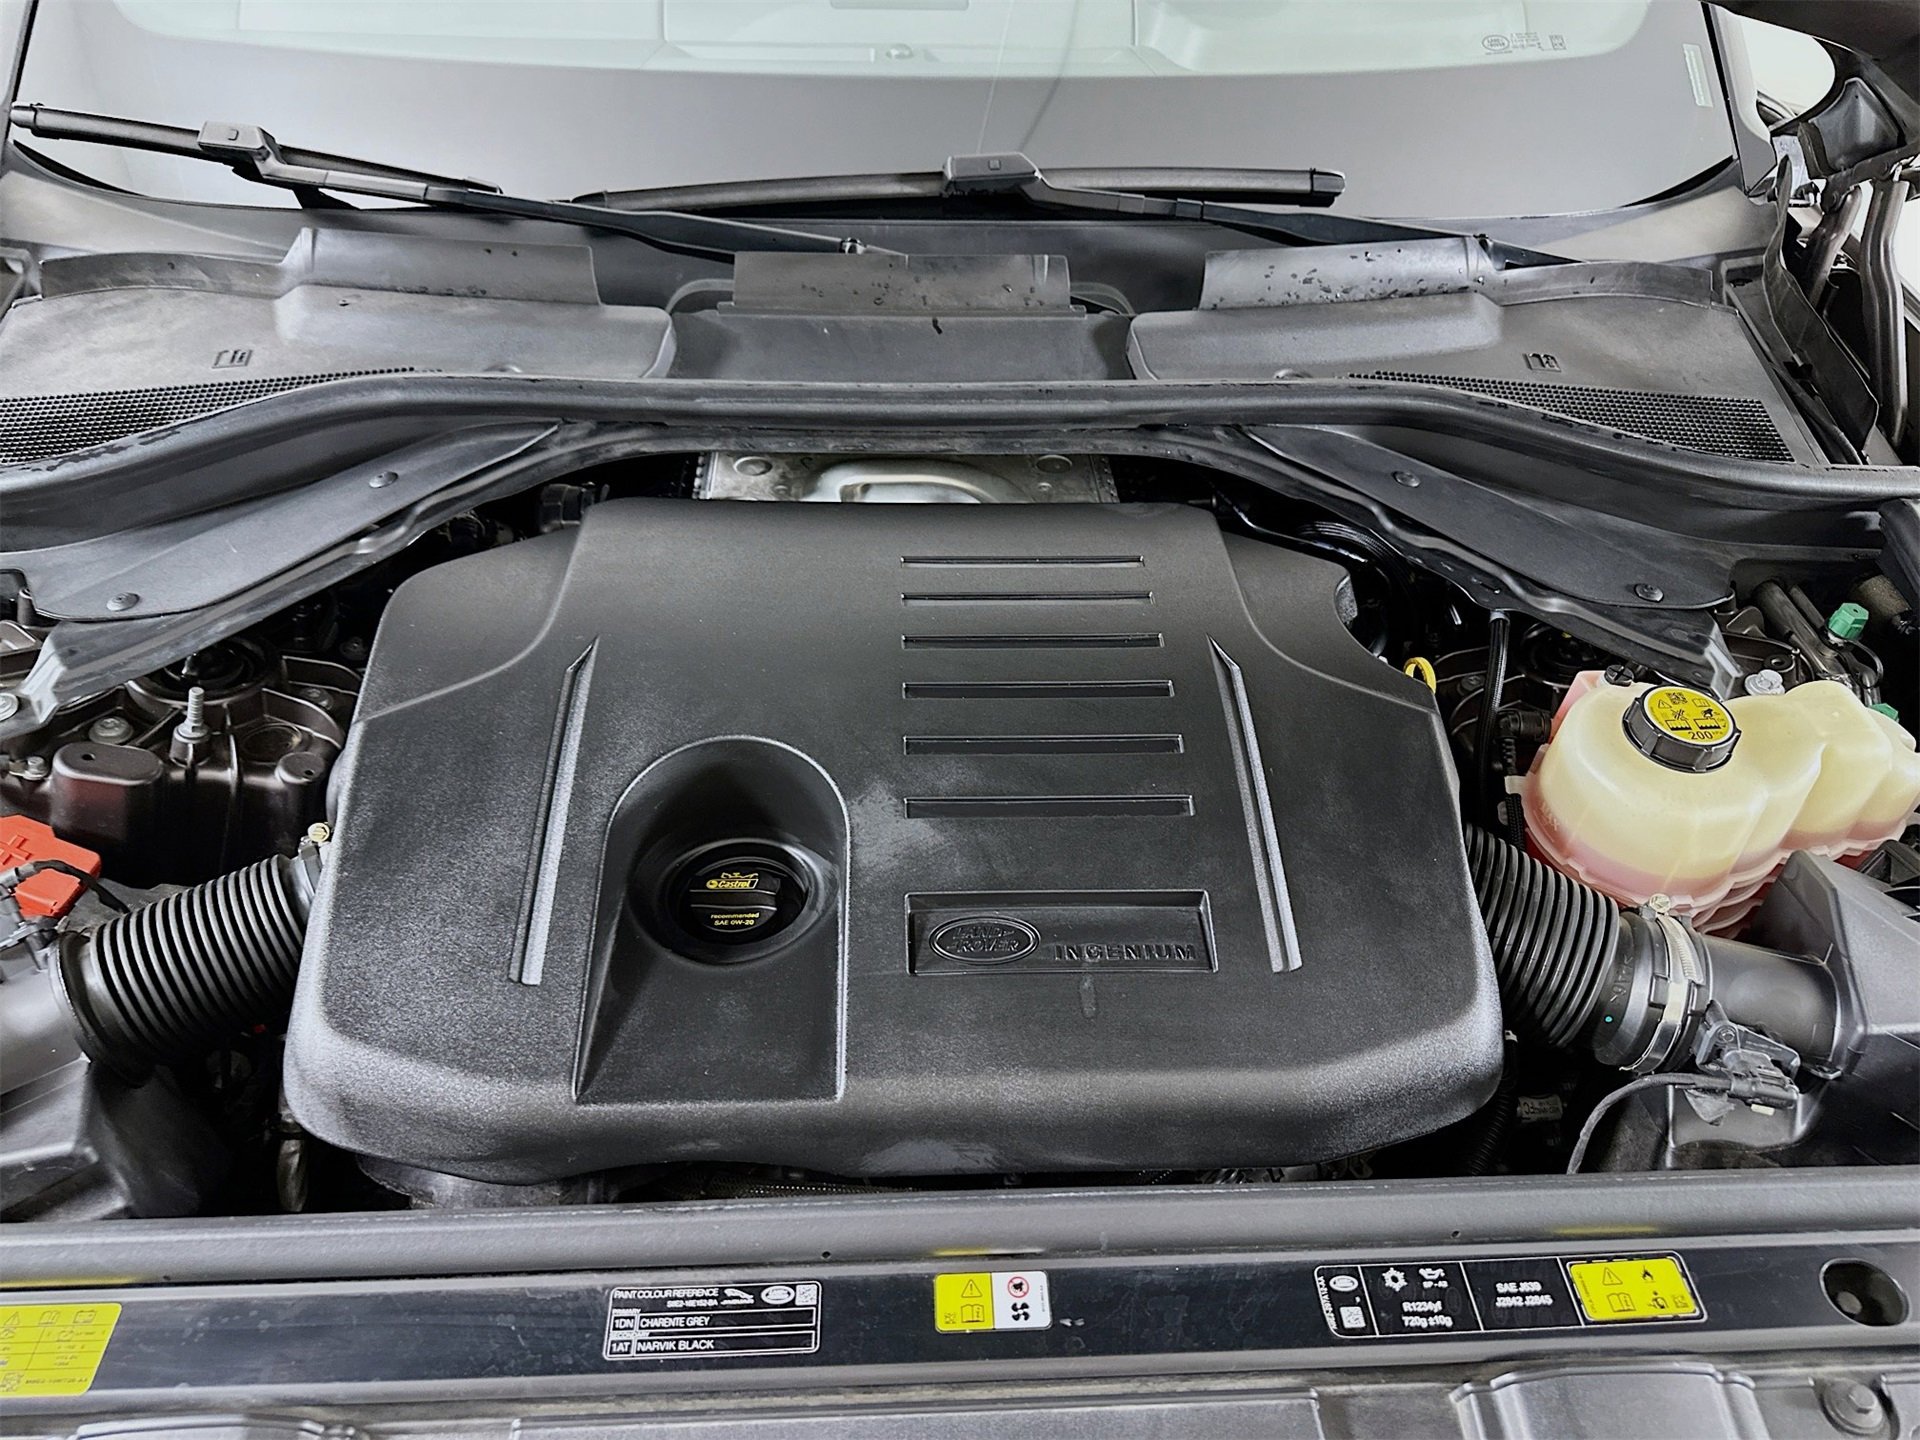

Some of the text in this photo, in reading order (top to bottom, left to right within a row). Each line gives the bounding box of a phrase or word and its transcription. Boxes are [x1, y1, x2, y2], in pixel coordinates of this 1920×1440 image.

[1688, 731, 1714, 741] 200
[717, 880, 751, 889] Castrol
[956, 939, 1019, 952] ROVER
[1054, 943, 1198, 961] INGENIUM
[613, 1287, 719, 1299] PAINT COLOUR REFERENCE
[1495, 1282, 1518, 1293] SAE
[614, 1315, 710, 1329] 1DN CHARENTE GREY
[611, 1339, 715, 1353] 1AT NARVIK BLACK
